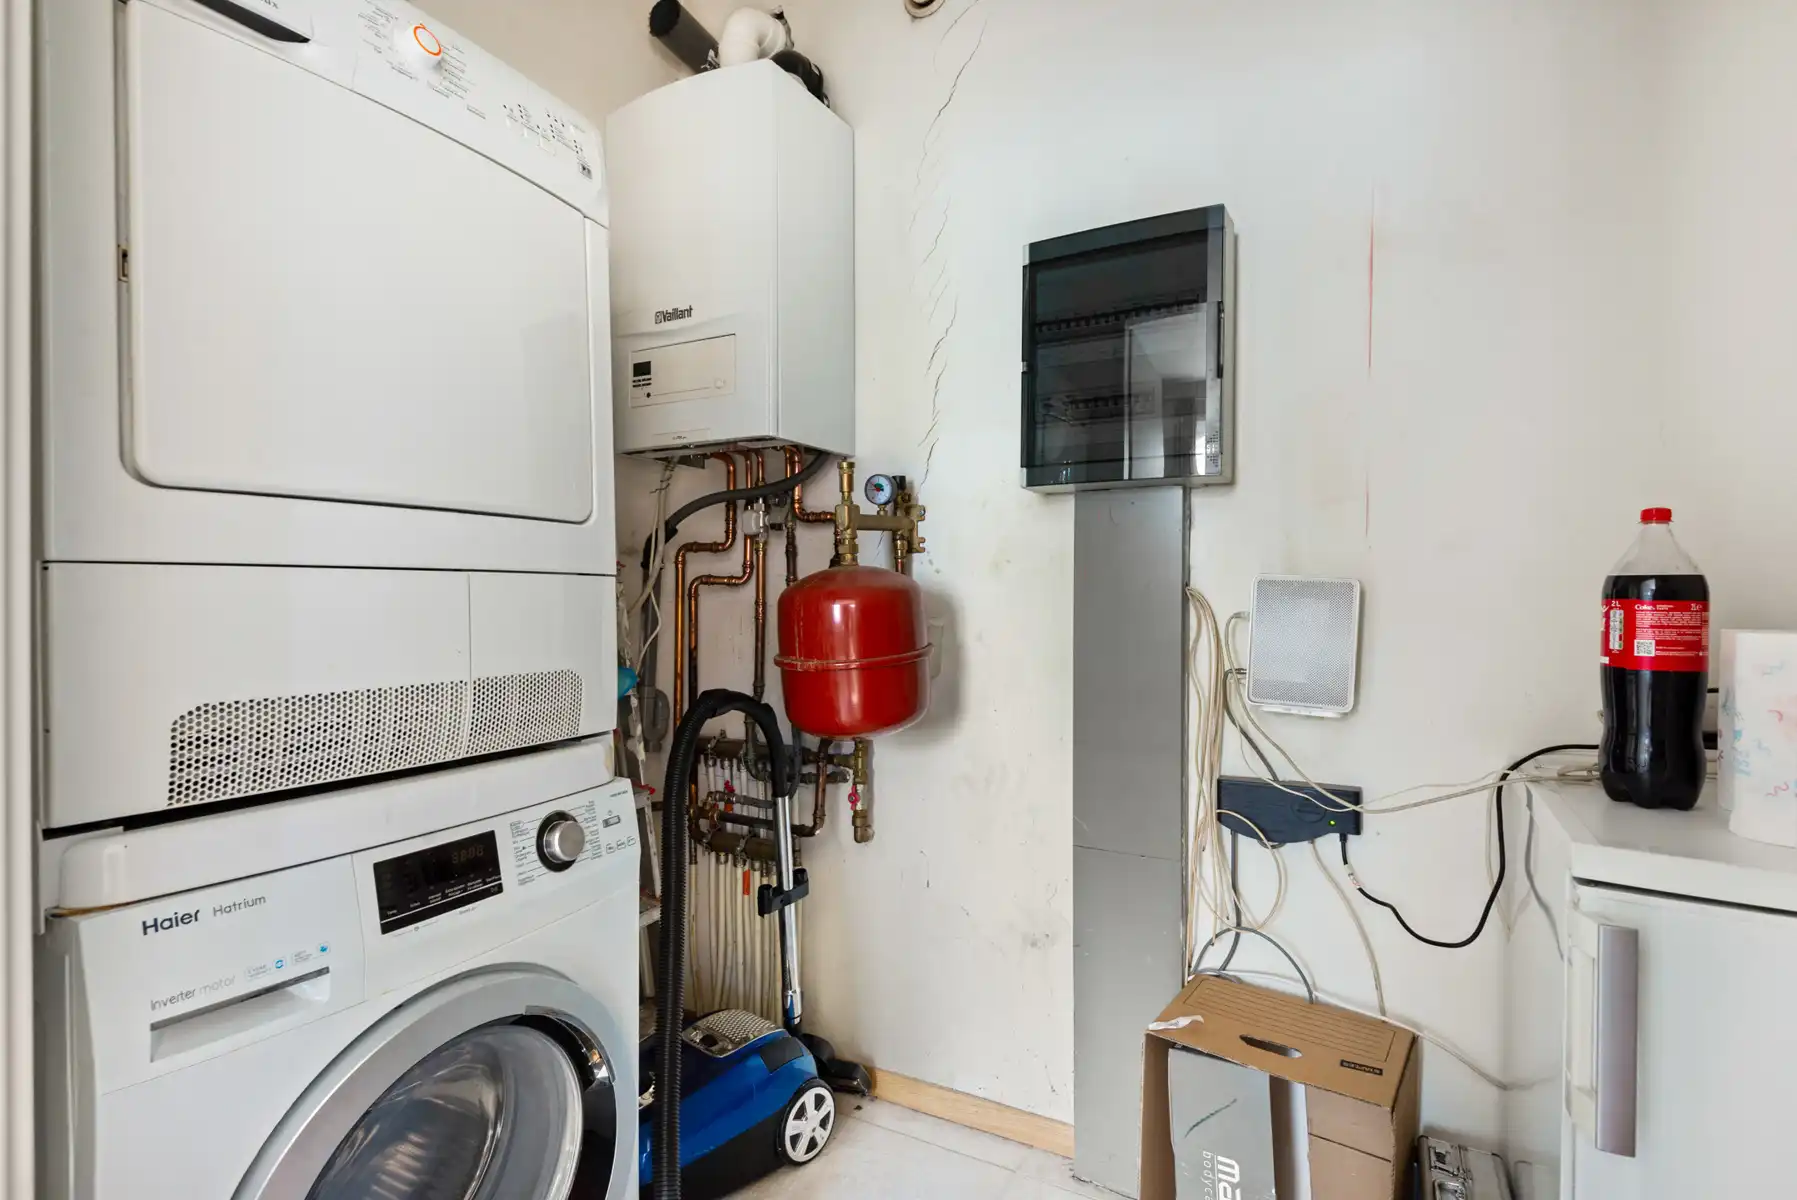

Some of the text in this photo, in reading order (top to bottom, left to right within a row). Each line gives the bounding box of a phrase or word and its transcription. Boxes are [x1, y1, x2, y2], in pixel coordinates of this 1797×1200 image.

[662, 304, 693, 322] Vaillant
[142, 895, 266, 936] Haier Hatrium
[150, 975, 236, 1011] Inverter motor
